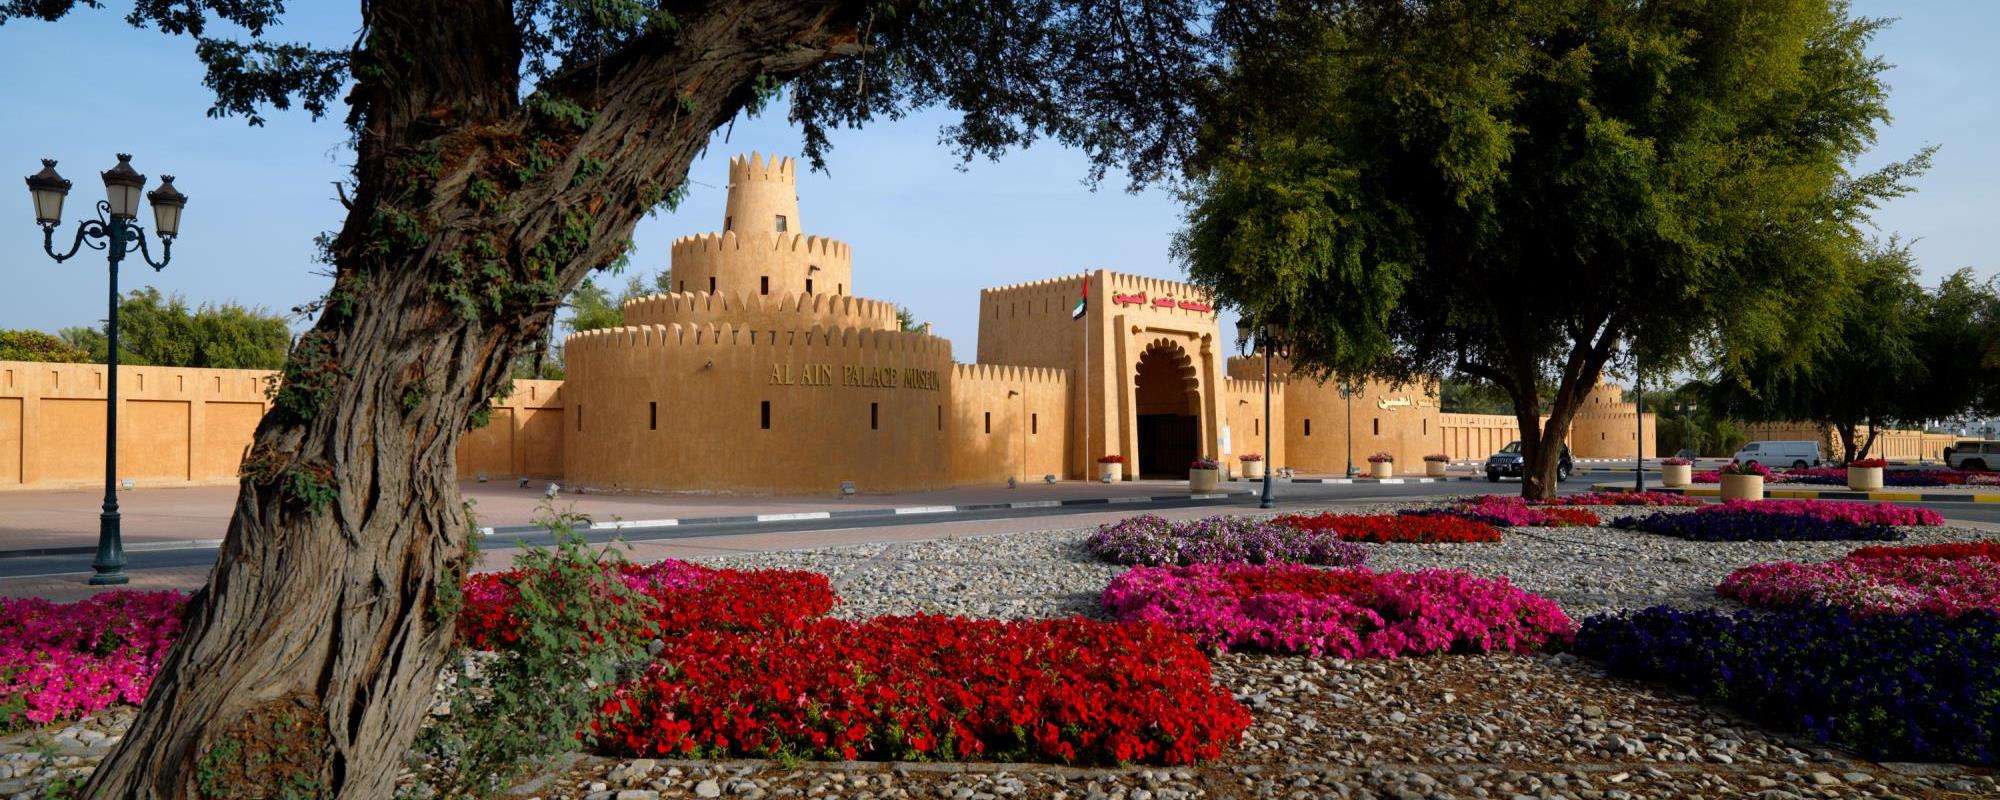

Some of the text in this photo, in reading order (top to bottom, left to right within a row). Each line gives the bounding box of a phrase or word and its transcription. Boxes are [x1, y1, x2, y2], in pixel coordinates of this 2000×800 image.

[769, 363, 940, 392] AL AIN PALACE MUSEUM
